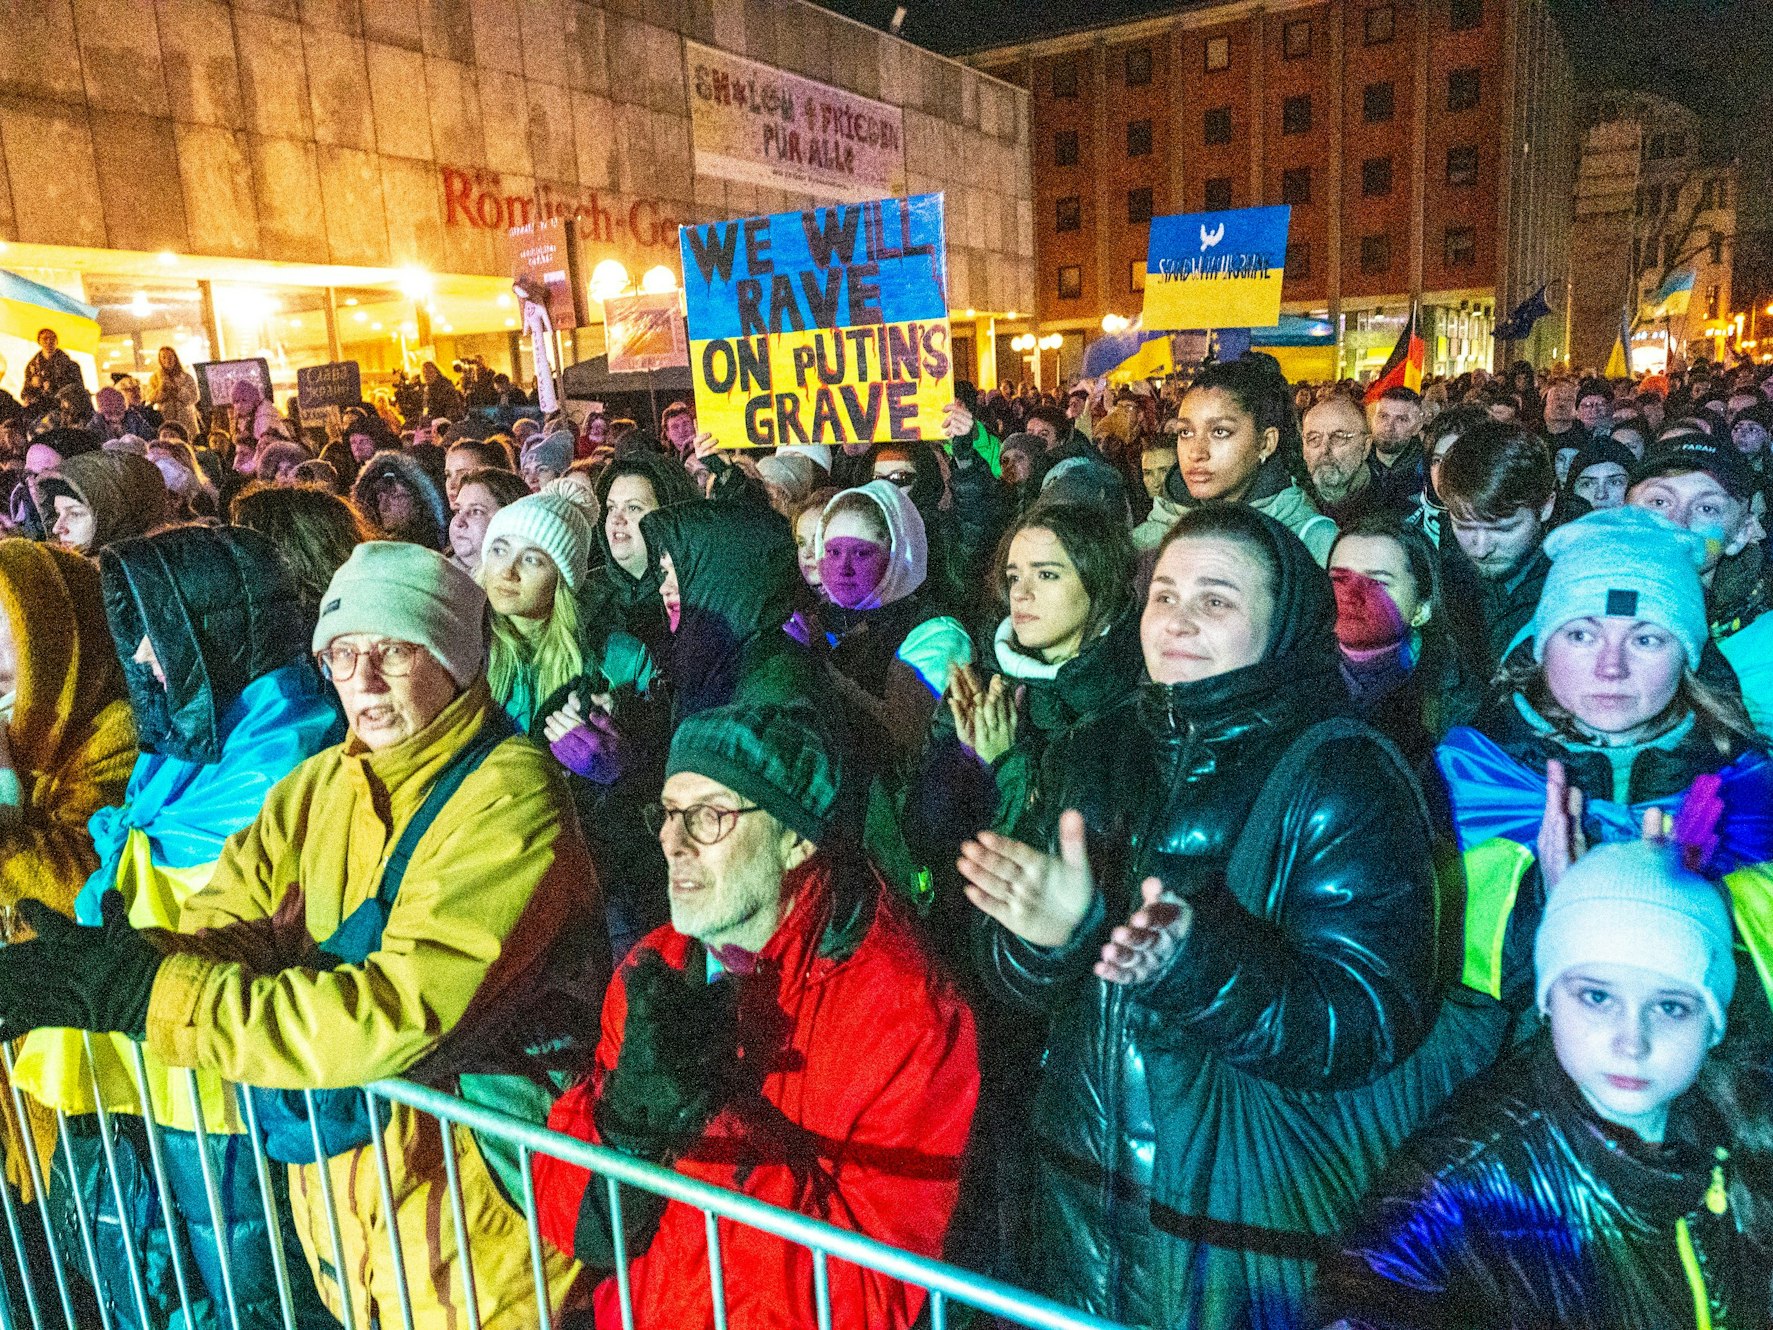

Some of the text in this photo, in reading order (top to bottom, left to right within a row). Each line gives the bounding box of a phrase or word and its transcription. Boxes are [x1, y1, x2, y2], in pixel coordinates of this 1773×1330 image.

[808, 136, 854, 175] ALLE
[686, 197, 936, 288] WE WILL
[737, 261, 884, 338] RAVE
[702, 322, 950, 395] ON PUTIN'S
[744, 380, 922, 446] GRAVE
